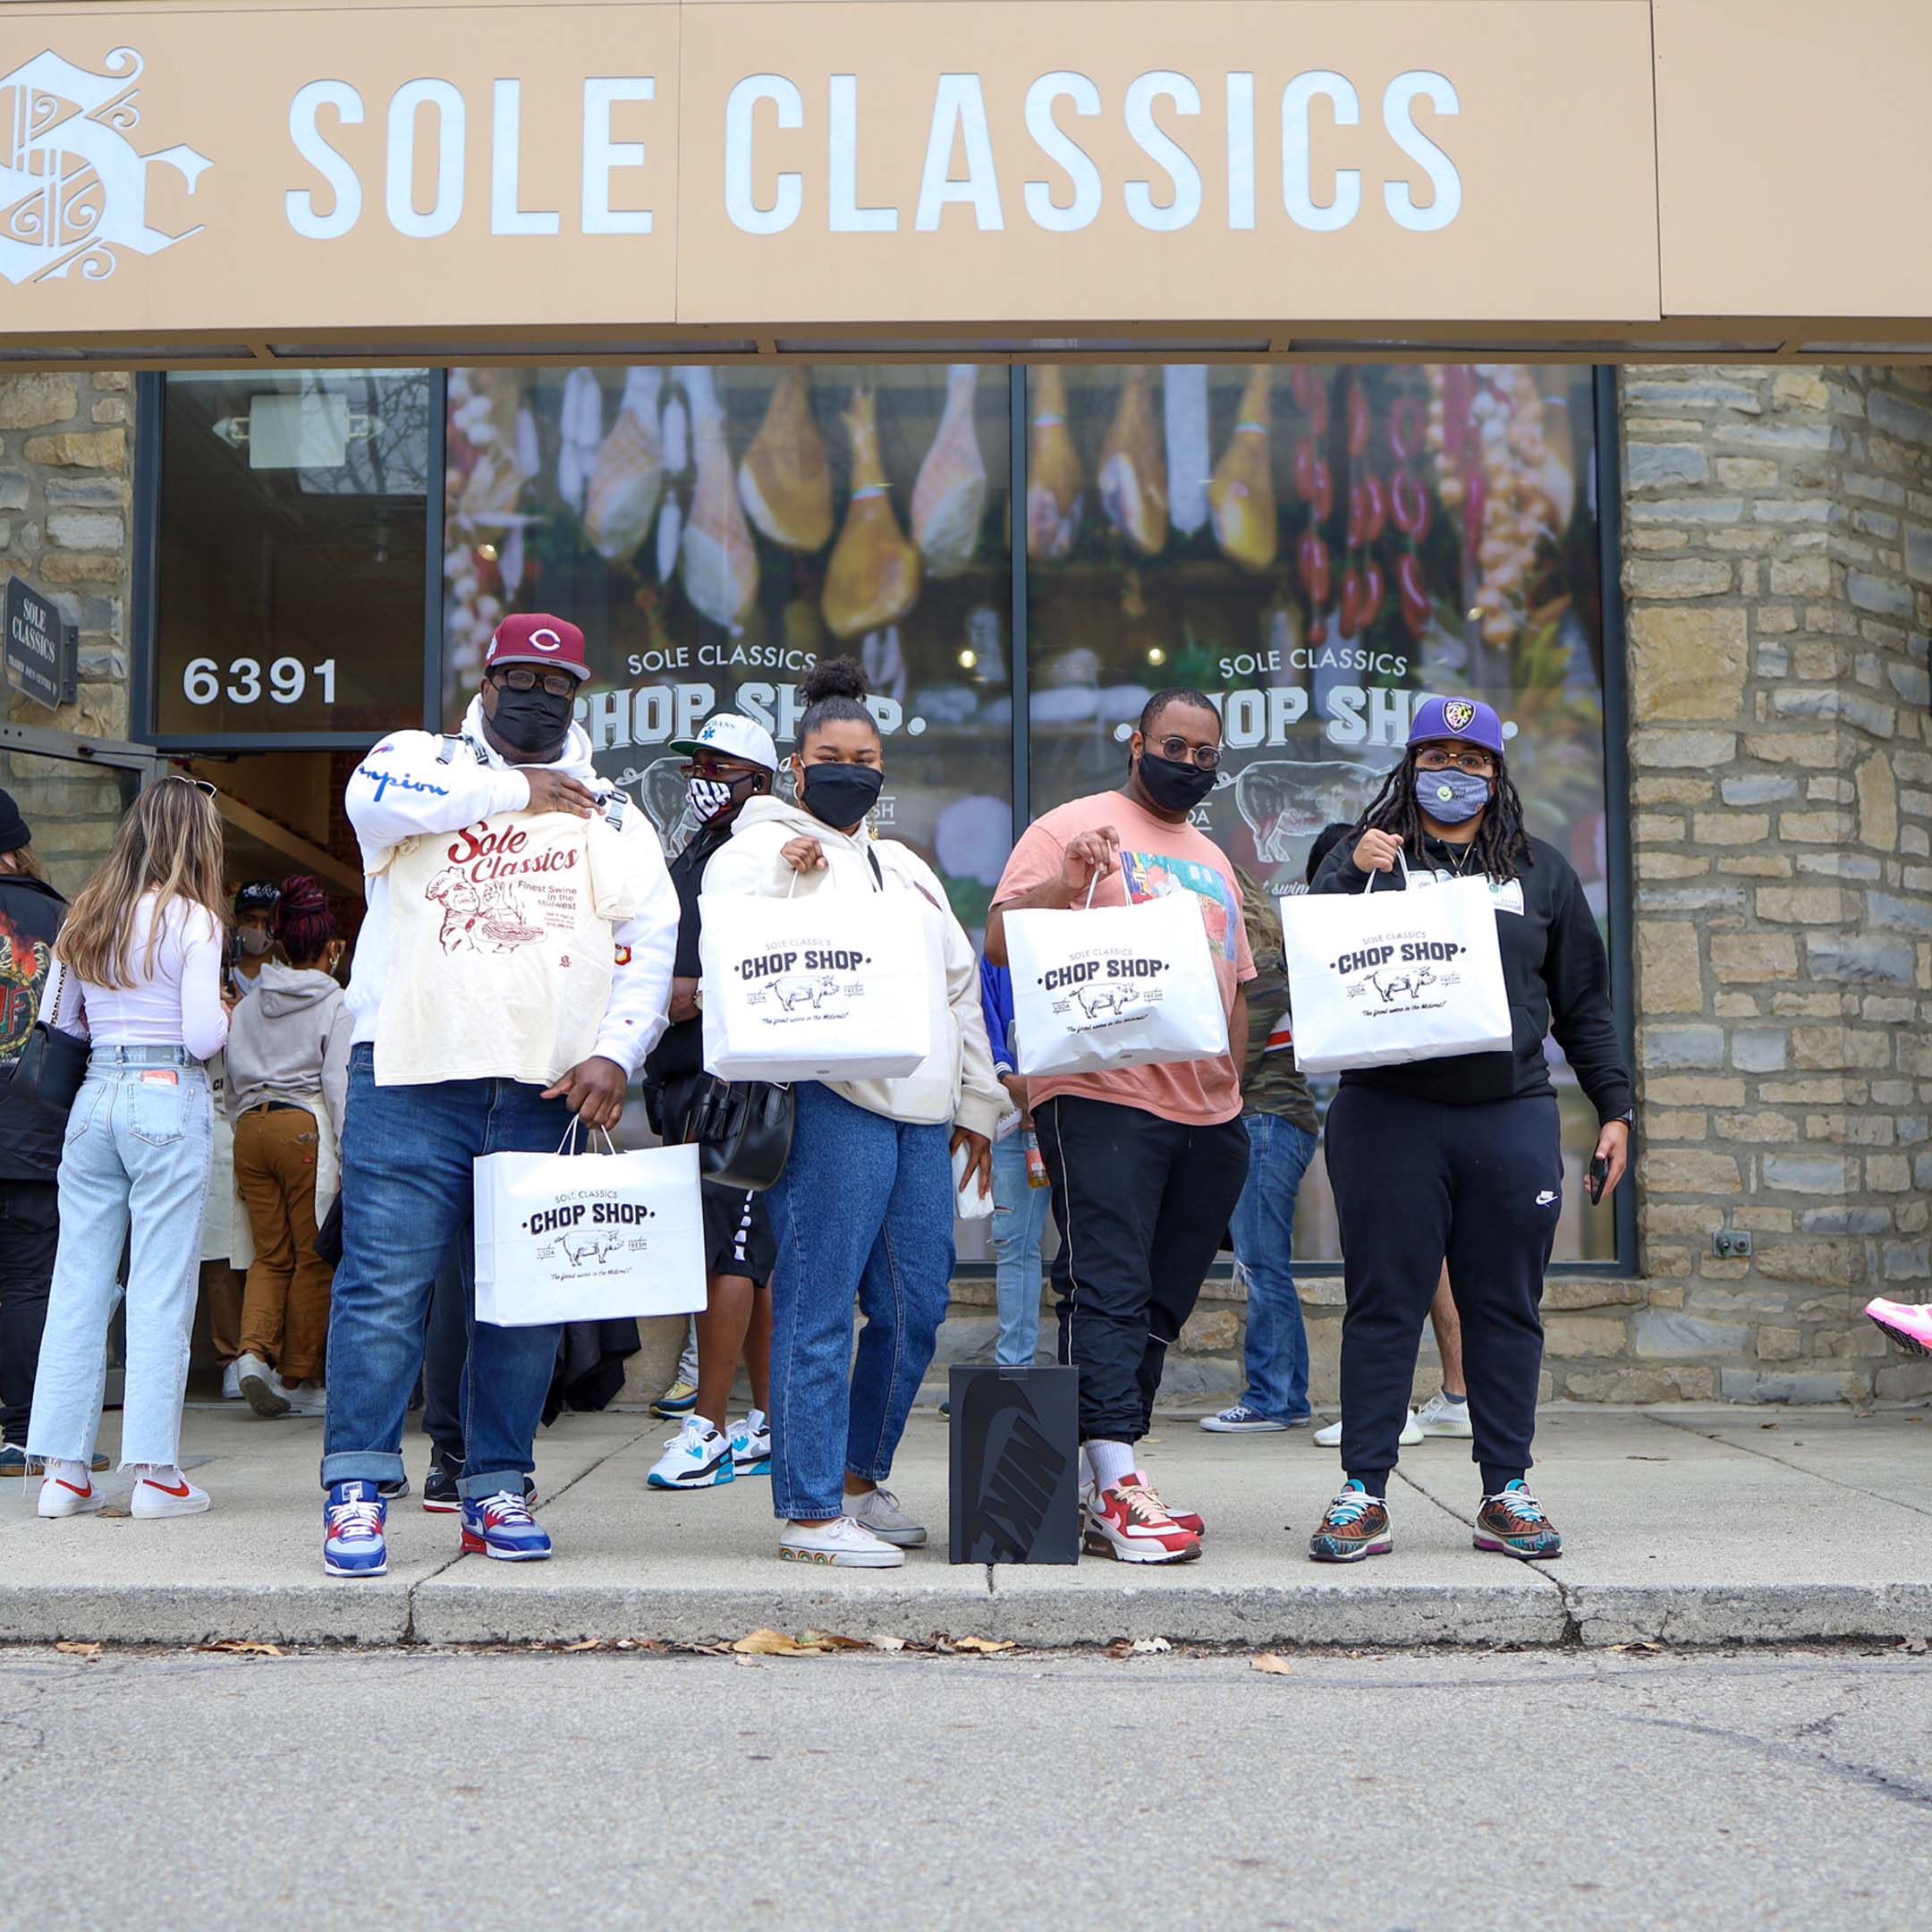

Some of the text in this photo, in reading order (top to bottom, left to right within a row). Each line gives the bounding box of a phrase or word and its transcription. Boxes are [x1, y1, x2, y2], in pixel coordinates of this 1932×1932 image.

[286, 69, 1462, 240] SOLE CLASSICS
[23, 597, 47, 632] SOLE
[12, 615, 55, 664] CLASSICS
[628, 643, 818, 675] SOLE CLASSICS
[1219, 648, 1408, 679] SOLE CLASSICS
[182, 657, 335, 705] 6391
[573, 682, 716, 751] HOP
[447, 820, 529, 864] Sole
[470, 847, 580, 884] Classics
[518, 880, 577, 895] Finest Swine
[559, 894, 574, 902] the
[1361, 931, 1427, 945] SOLE CLASSICS
[741, 951, 864, 981] CHOP SHOP
[1069, 947, 1133, 962] SOLE CLASSICS
[1338, 942, 1459, 975] CHOP SHOP
[1045, 959, 1163, 991] CHOP SHOP
[555, 1190, 619, 1204] SOLE CLASSICS
[530, 1203, 648, 1235] CHOP SHOP
